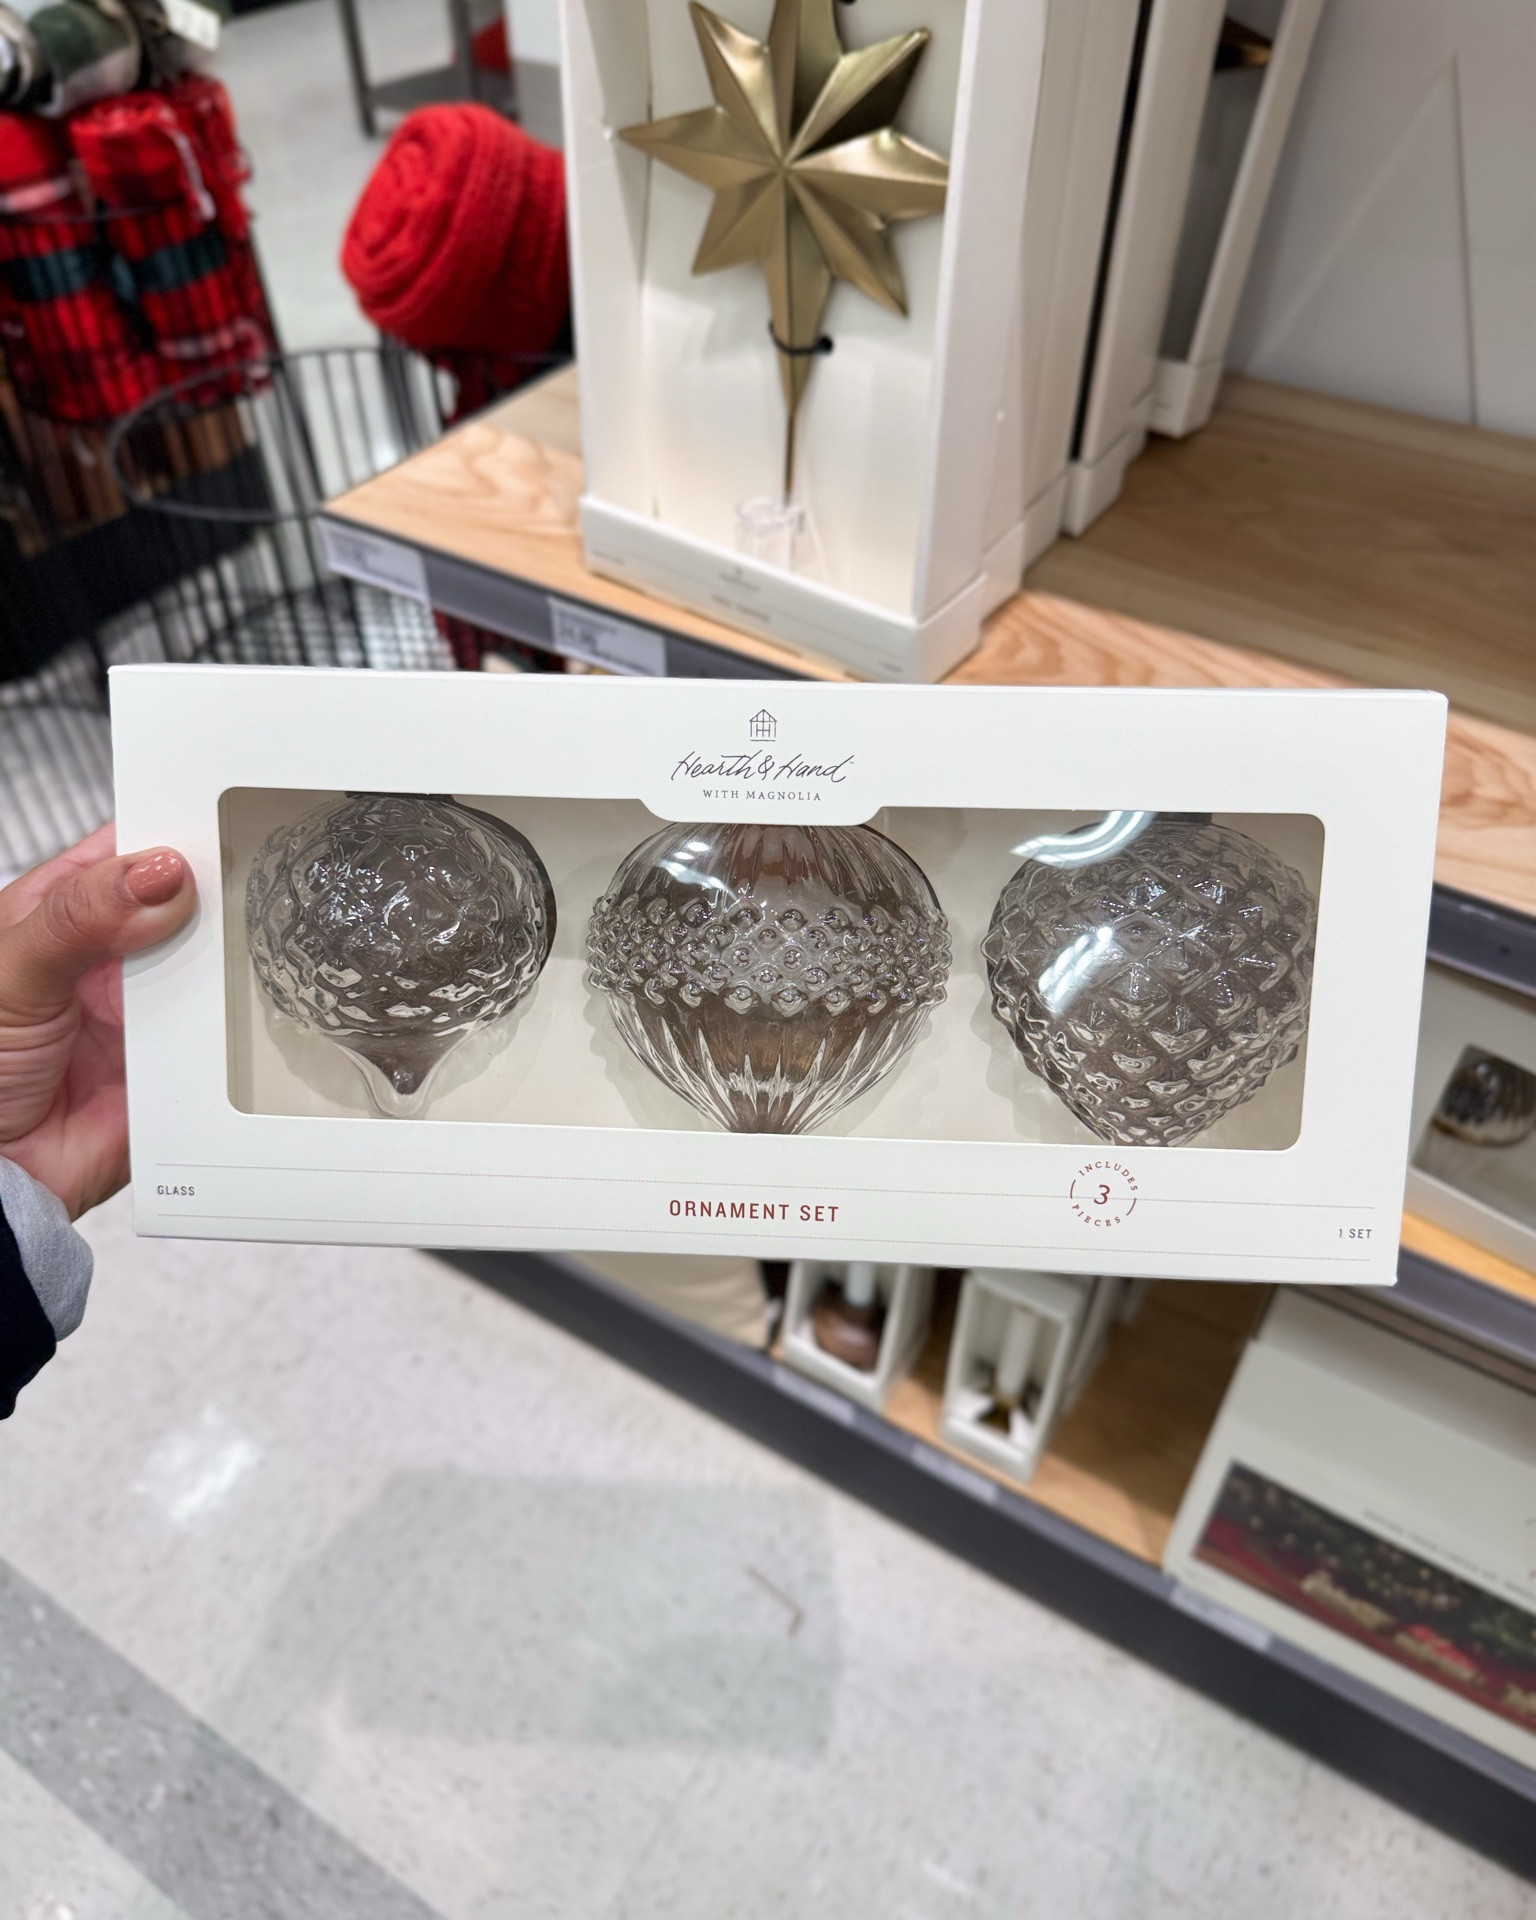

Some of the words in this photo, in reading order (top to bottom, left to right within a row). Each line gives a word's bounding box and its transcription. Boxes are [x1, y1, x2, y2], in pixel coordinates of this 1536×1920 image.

[670, 749, 763, 780] Hearth
[757, 755, 775, 780] &
[773, 753, 855, 783] Hand
[702, 789, 739, 799] WITH
[746, 791, 821, 801] MAGNOLIA
[1078, 1161, 1138, 1192] INCLUDES
[157, 1184, 195, 1196] GLASS
[1093, 1184, 1110, 1205] 3
[669, 1199, 790, 1220] ORNAMENT
[799, 1204, 839, 1222] SET
[1072, 1203, 1121, 1227] PIECES
[1338, 1228, 1343, 1239] 1
[1348, 1228, 1373, 1240] SET
